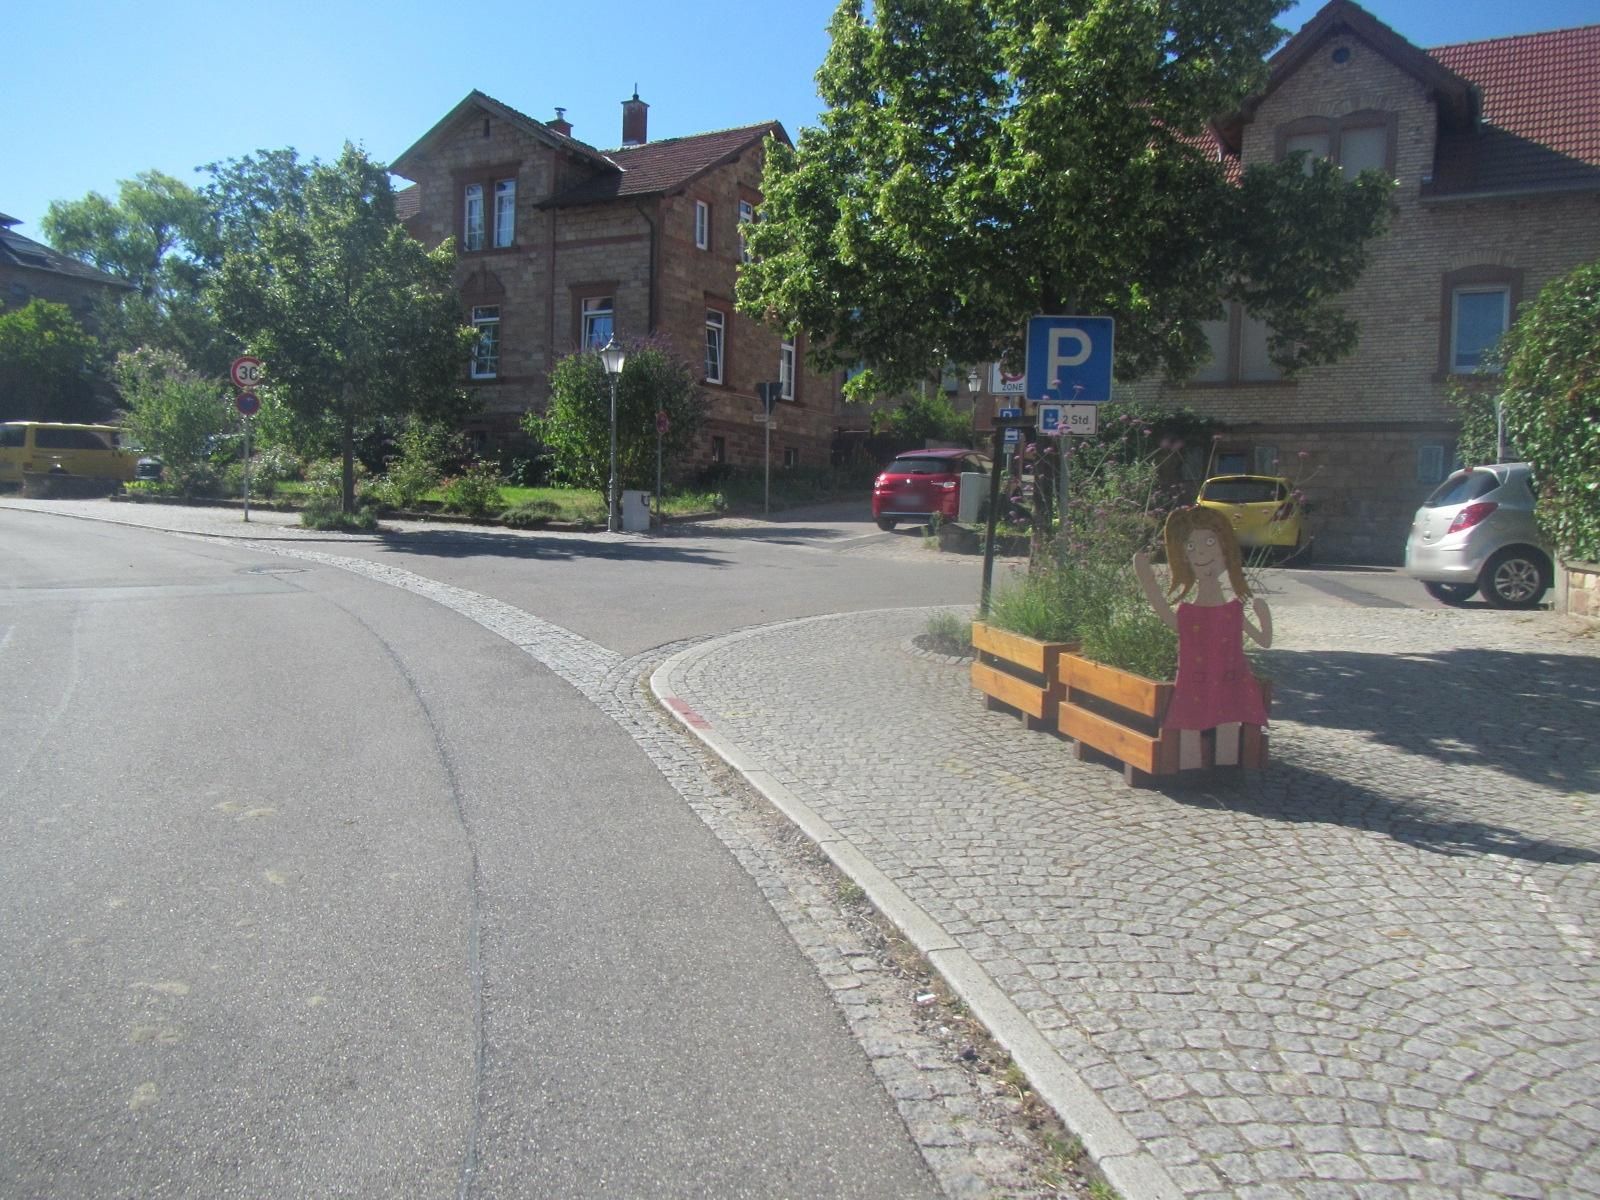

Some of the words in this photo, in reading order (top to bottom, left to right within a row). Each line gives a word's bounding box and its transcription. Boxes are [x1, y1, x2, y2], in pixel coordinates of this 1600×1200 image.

[1046, 328, 1093, 390] P
[239, 366, 259, 380] 30
[1002, 383, 1023, 391] ZONE
[1062, 415, 1069, 424] 2
[1071, 415, 1089, 424] Std
